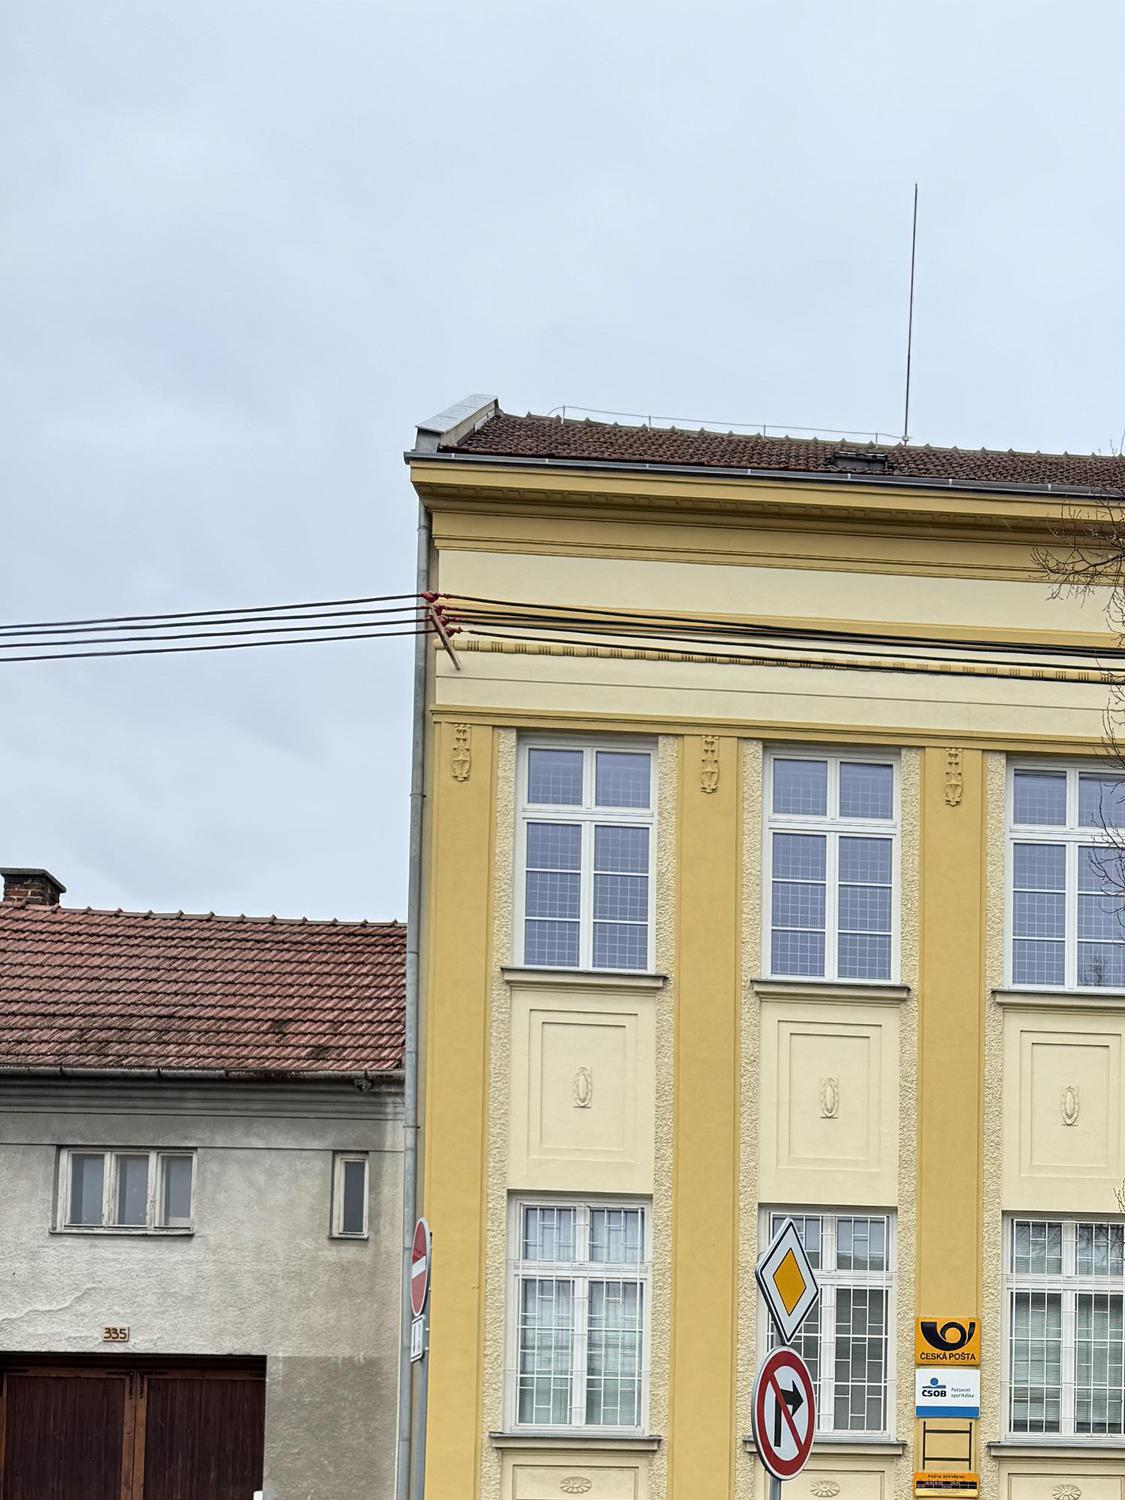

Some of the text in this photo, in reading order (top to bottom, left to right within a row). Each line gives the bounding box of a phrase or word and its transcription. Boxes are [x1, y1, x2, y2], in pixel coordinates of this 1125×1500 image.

[103, 1327, 127, 1340] 335
[920, 1351, 976, 1361] ČESKÁ POŠTA
